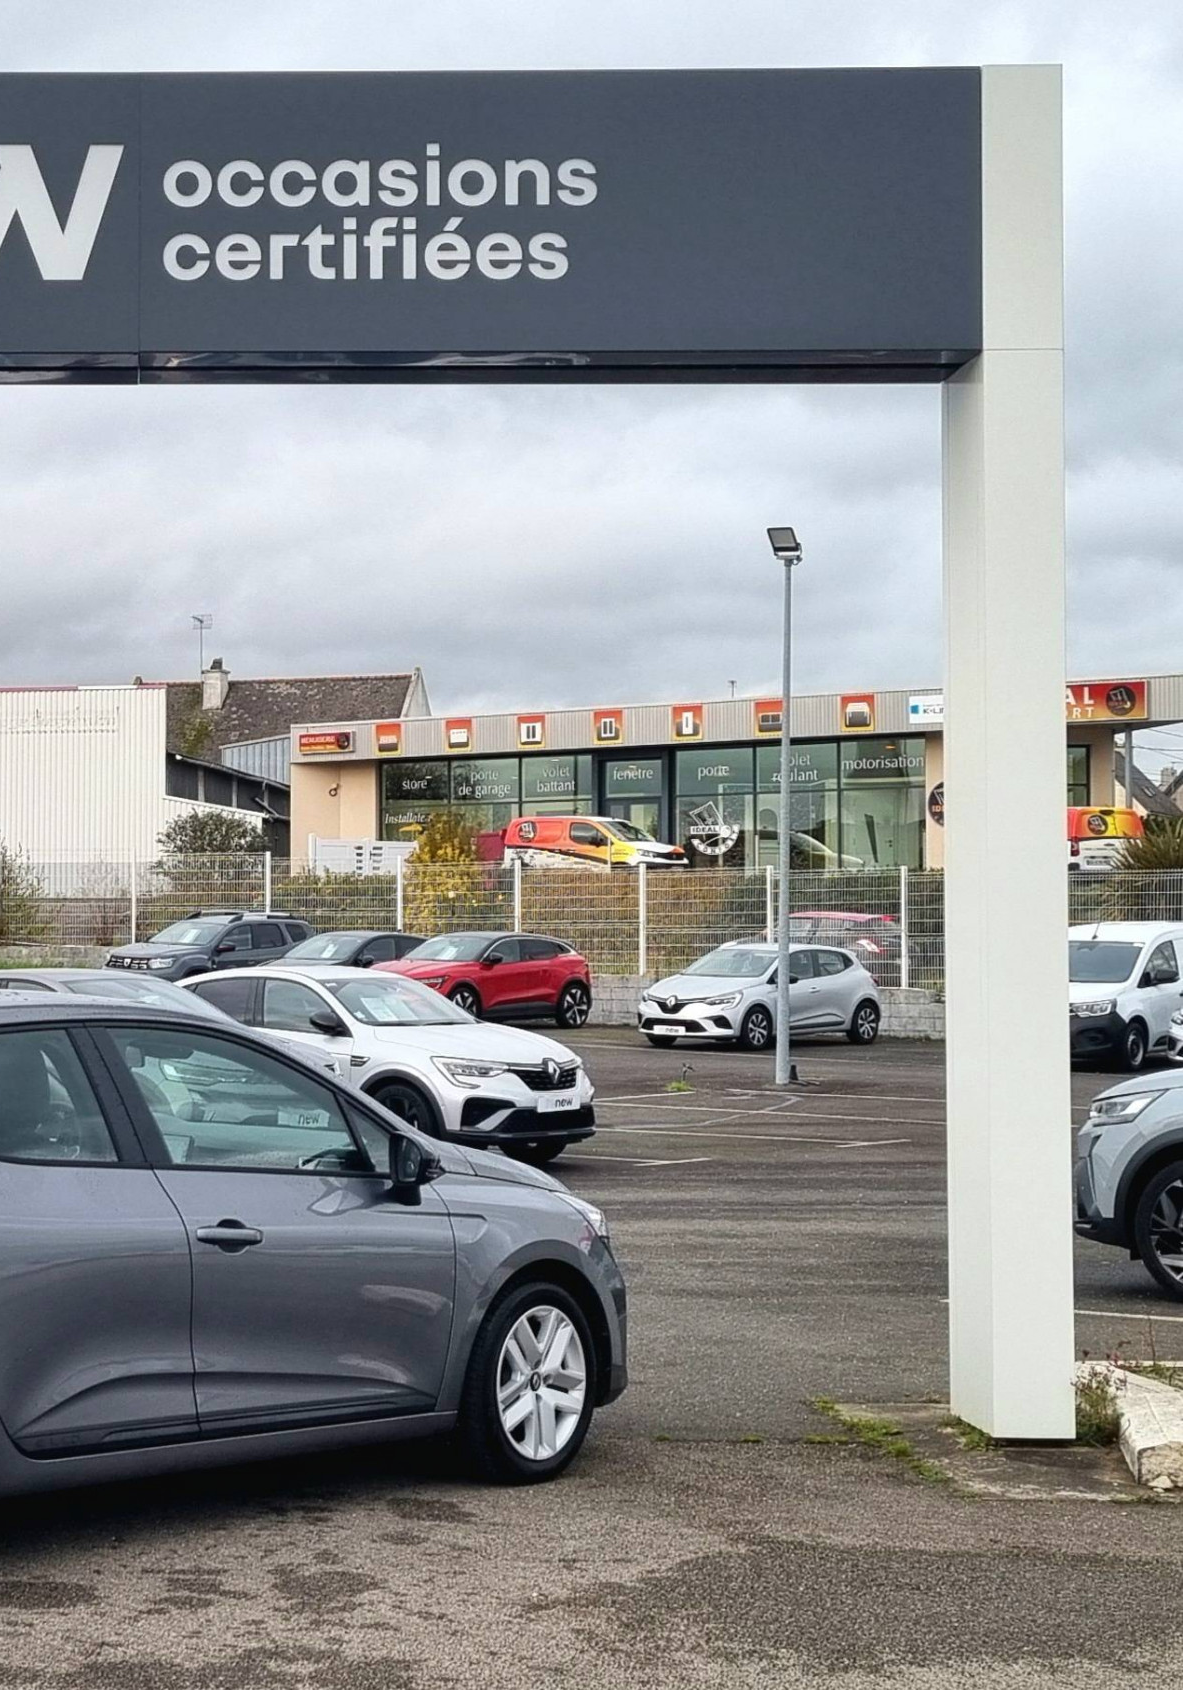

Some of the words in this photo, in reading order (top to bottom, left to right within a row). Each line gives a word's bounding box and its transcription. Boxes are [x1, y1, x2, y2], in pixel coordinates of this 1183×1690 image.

[162, 142, 599, 208] occasions
[162, 216, 570, 281] certifiées
[542, 764, 570, 778] volet
[841, 754, 924, 771] motorisation
[470, 769, 499, 784] porte
[697, 764, 730, 782] porte
[402, 778, 428, 790] store
[458, 782, 472, 796] de
[475, 783, 511, 799] garage
[536, 779, 576, 793] battant
